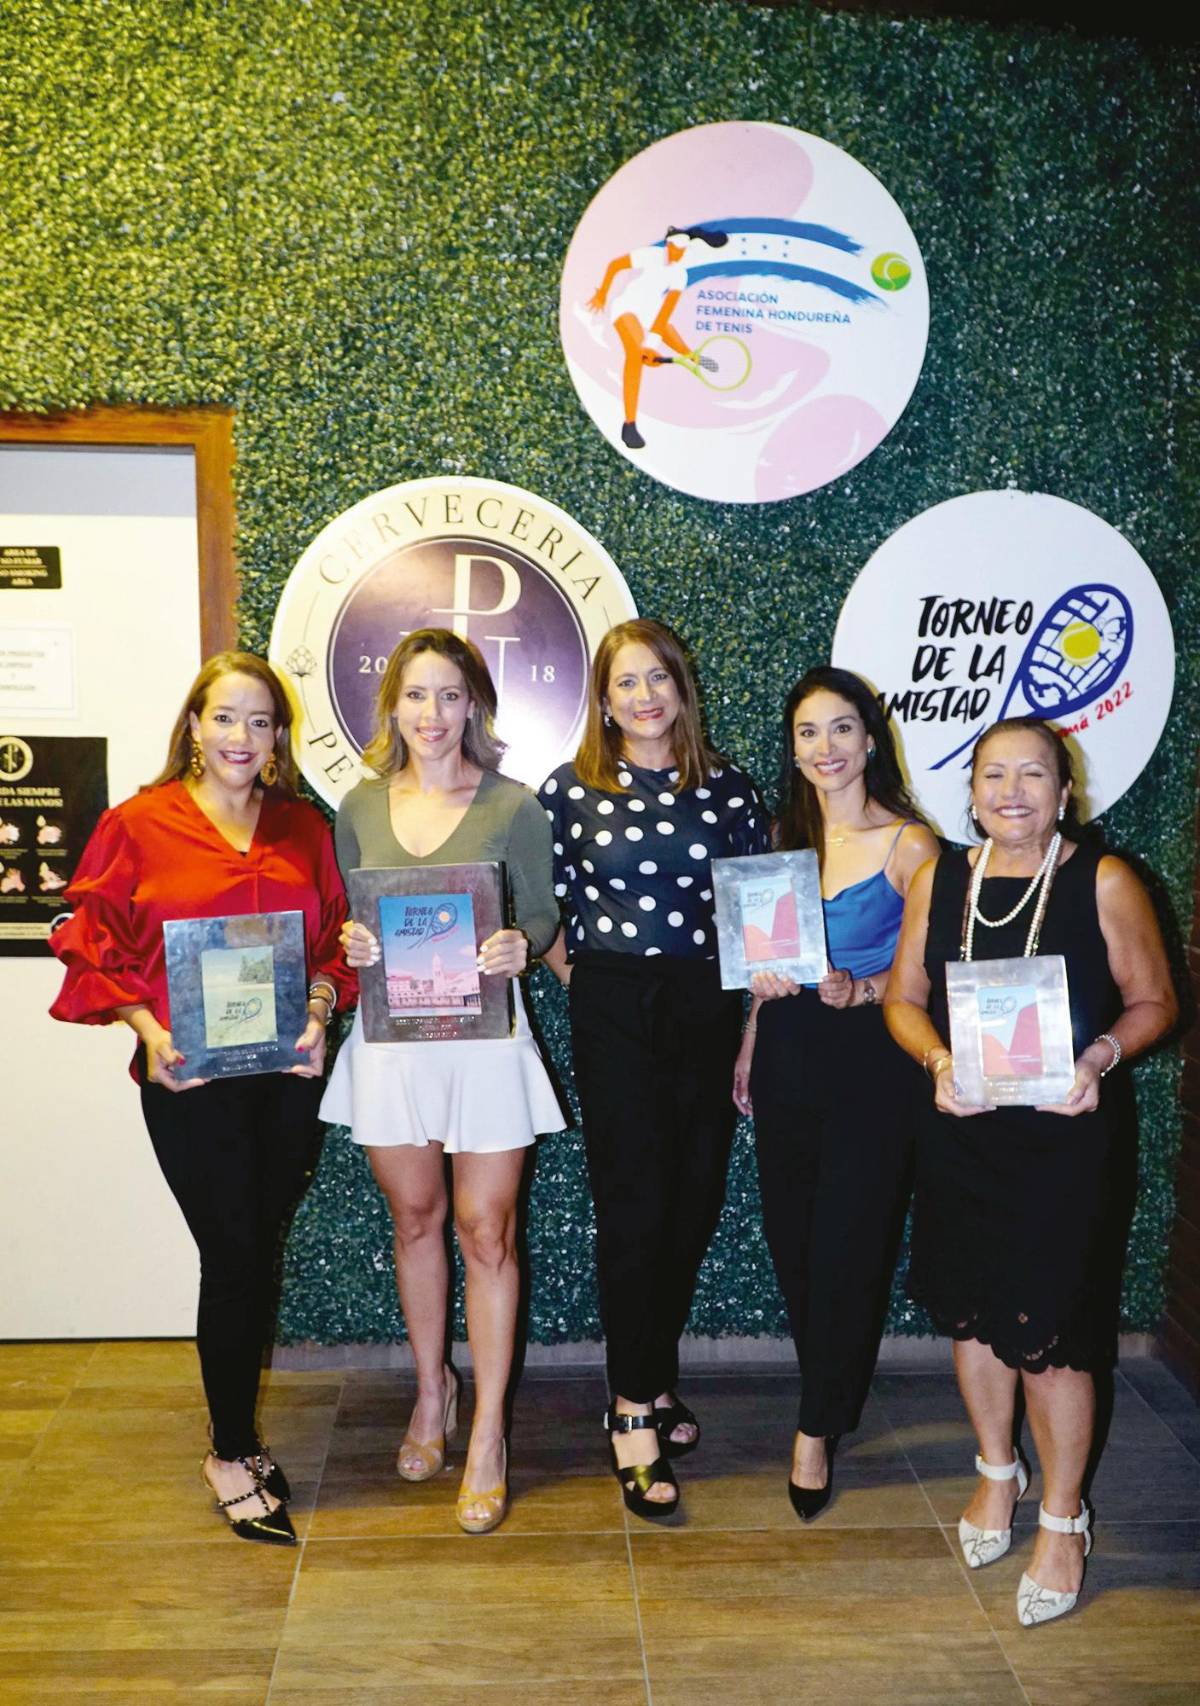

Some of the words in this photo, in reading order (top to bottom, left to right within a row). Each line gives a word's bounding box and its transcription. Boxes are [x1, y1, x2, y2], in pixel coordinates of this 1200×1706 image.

[697, 289, 779, 304] ASOCIACIÓN
[696, 305, 764, 319] FEMENINA
[768, 309, 851, 324] HONDUREÑA
[696, 321, 712, 332] DE
[716, 321, 753, 334] TENIS
[318, 493, 606, 603] CERVECERIA
[918, 594, 1034, 639] TORNEO
[358, 655, 389, 674] 20
[530, 664, 556, 683] 18
[911, 644, 956, 683] DE
[968, 644, 1007, 685] LA
[1095, 681, 1134, 721] 2022
[16, 787, 61, 797] SIEMPRE
